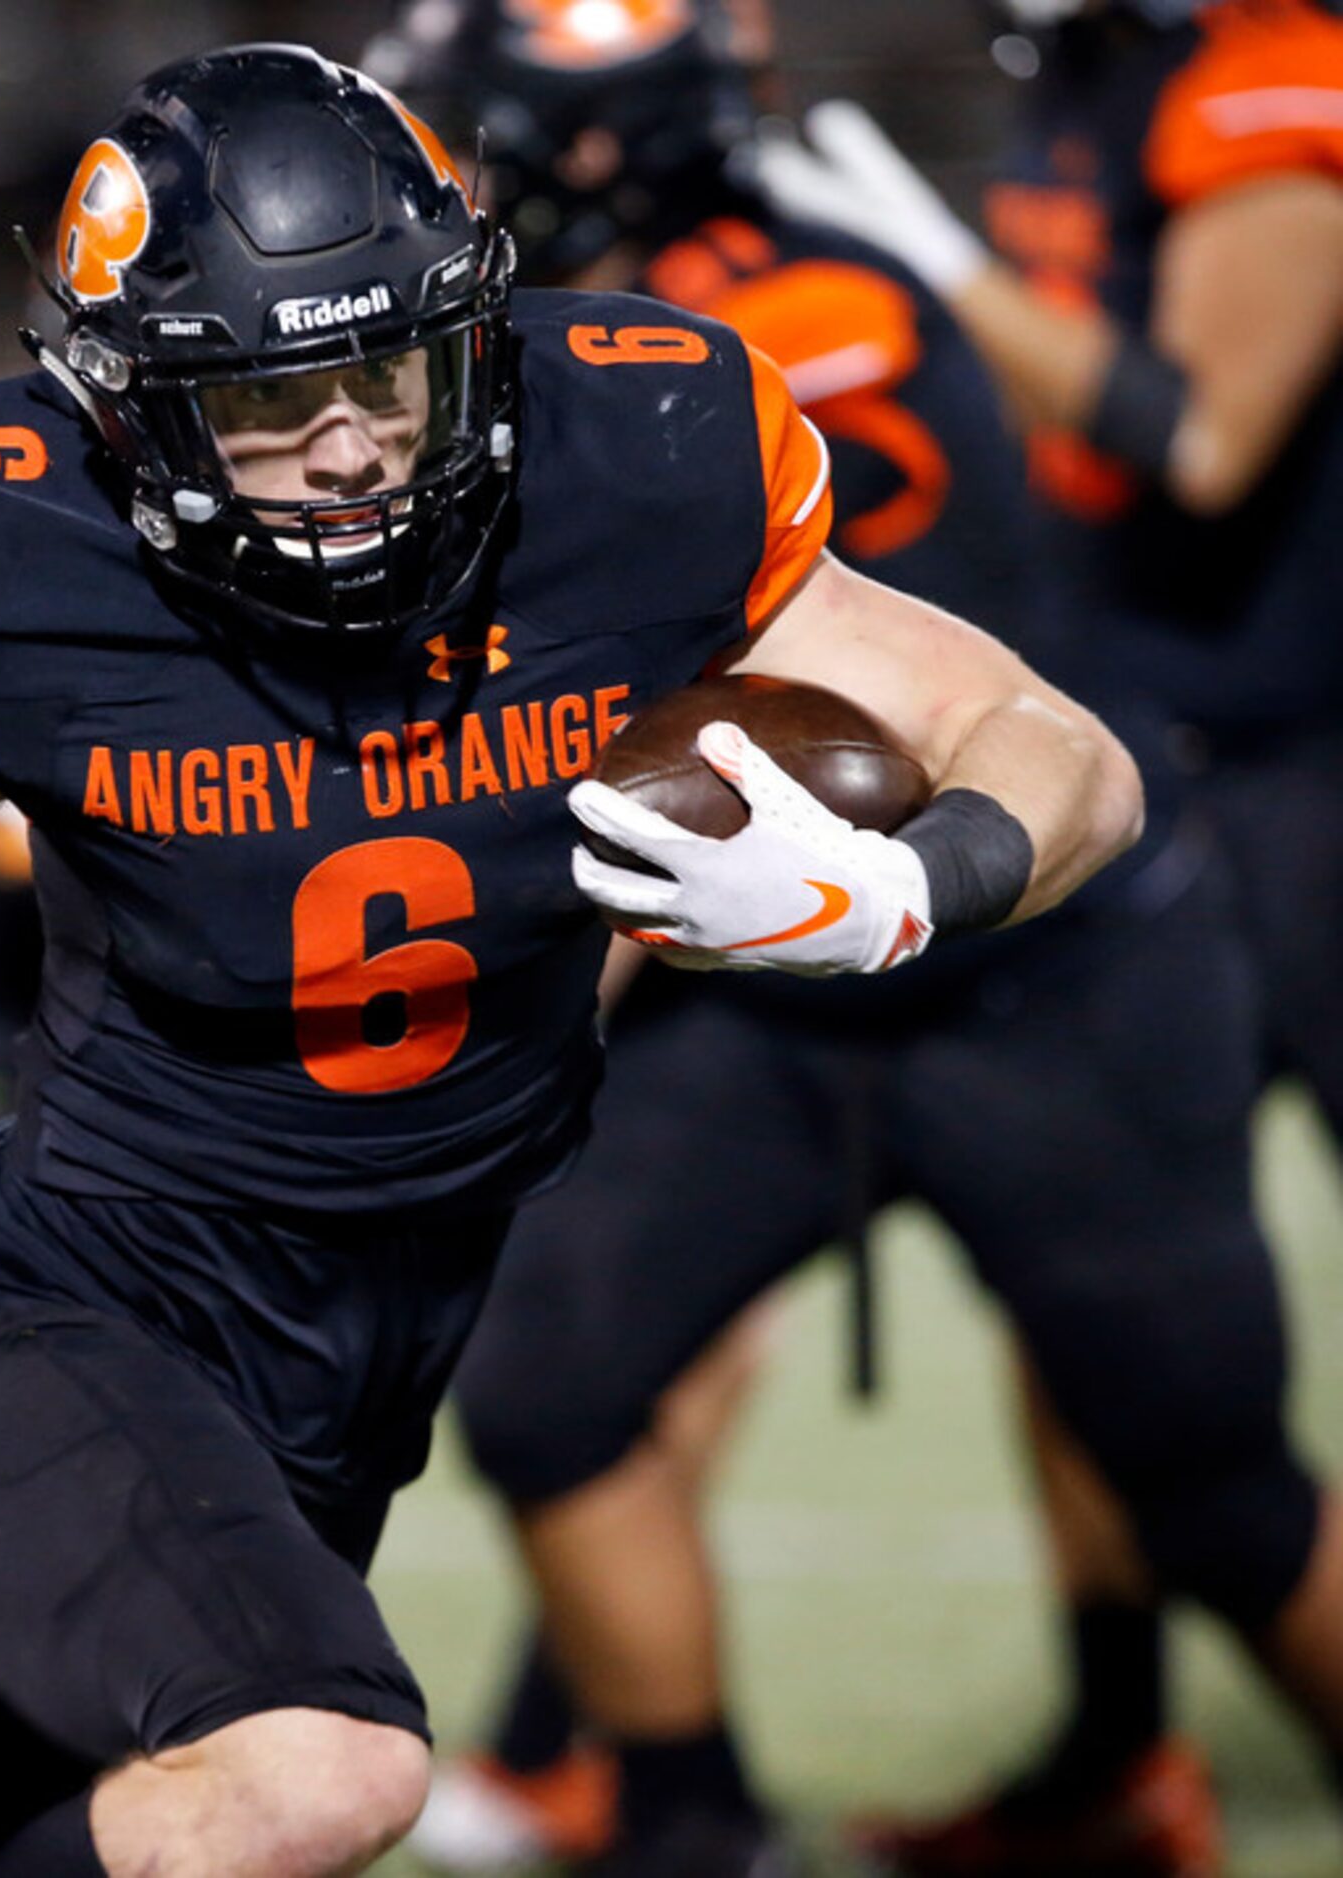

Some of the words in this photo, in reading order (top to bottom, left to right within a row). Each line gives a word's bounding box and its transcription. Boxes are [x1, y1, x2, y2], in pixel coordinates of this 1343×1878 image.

[278, 285, 392, 334] Riddell
[568, 325, 709, 366] 6
[83, 737, 315, 836] ANGRY
[291, 836, 478, 1094] 6
